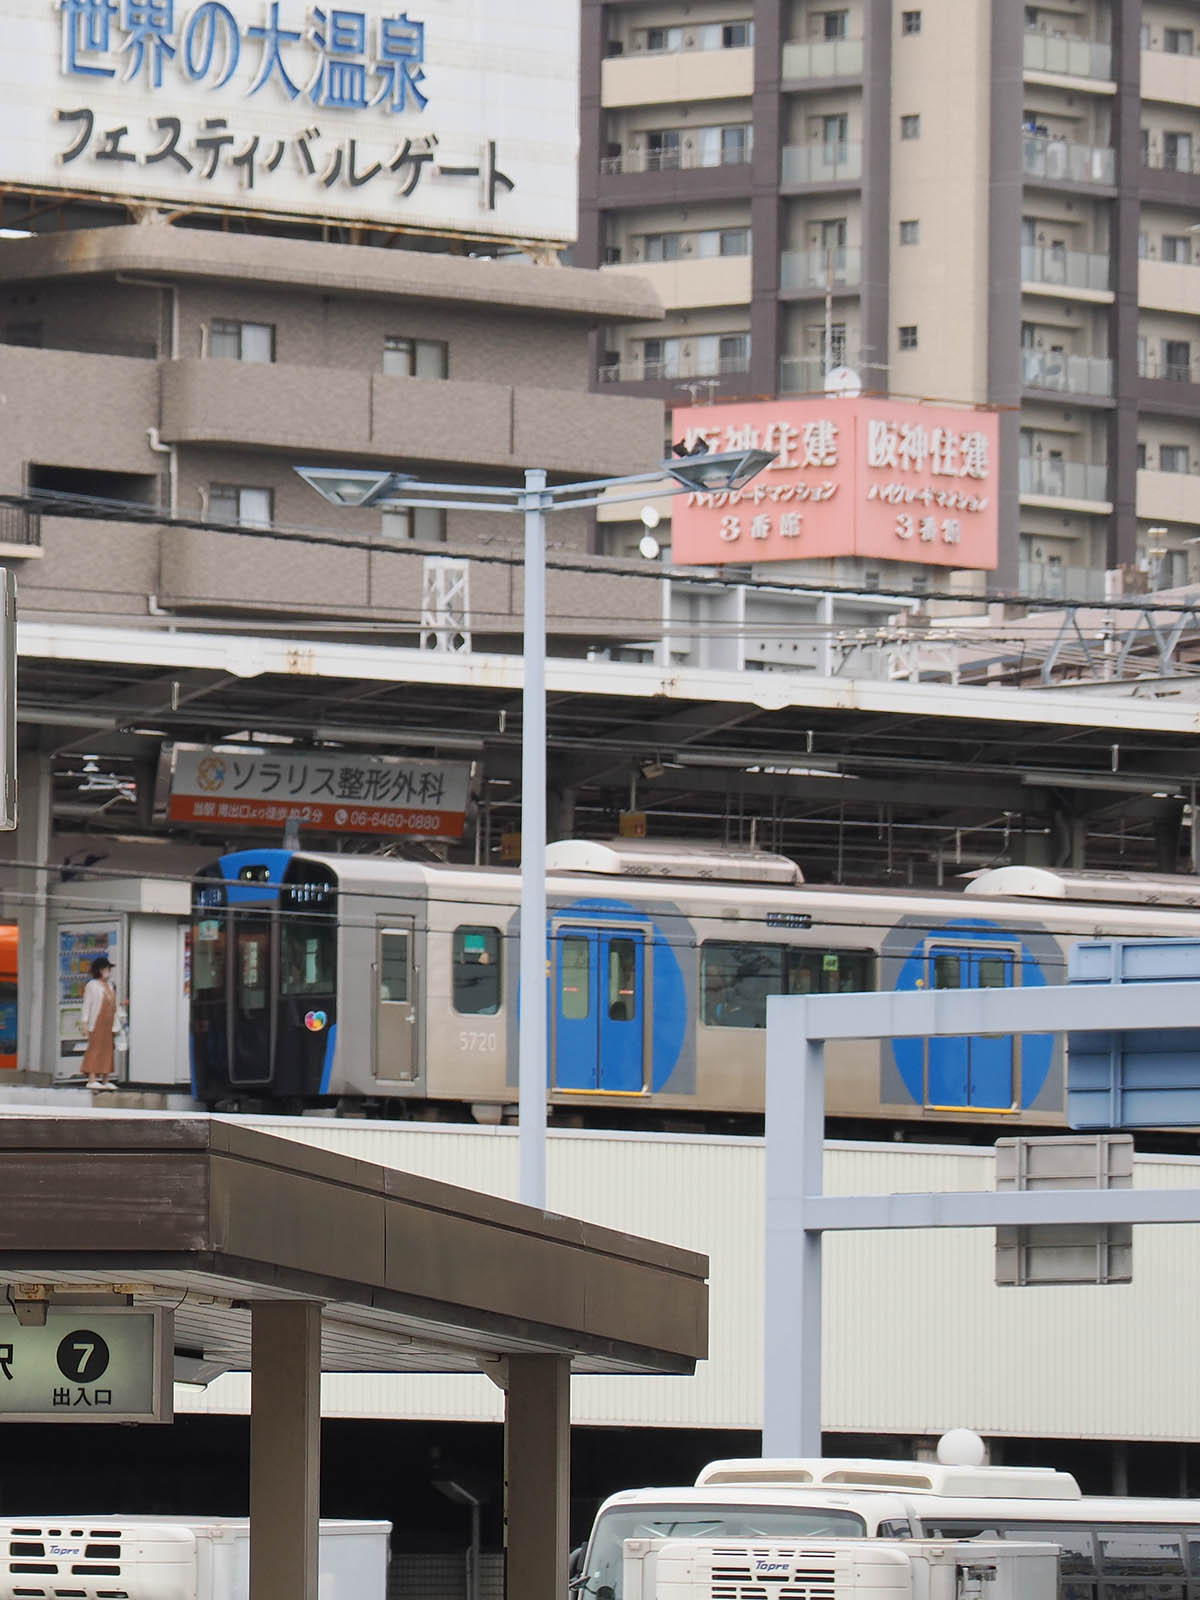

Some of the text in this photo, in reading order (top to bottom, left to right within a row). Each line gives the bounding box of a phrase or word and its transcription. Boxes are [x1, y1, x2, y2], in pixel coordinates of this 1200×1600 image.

[57, 0, 429, 113] 世界の大温泉
[53, 108, 515, 210] フェスティバルゲート
[867, 419, 990, 480] 阪神住建
[232, 761, 446, 805] ソラリス整形外科
[458, 1031, 498, 1052] 5720
[70, 1343, 96, 1374] 7
[52, 1387, 113, 1407] 出入口
[49, 1545, 80, 1556] Topre
[755, 1560, 789, 1571] Topre
